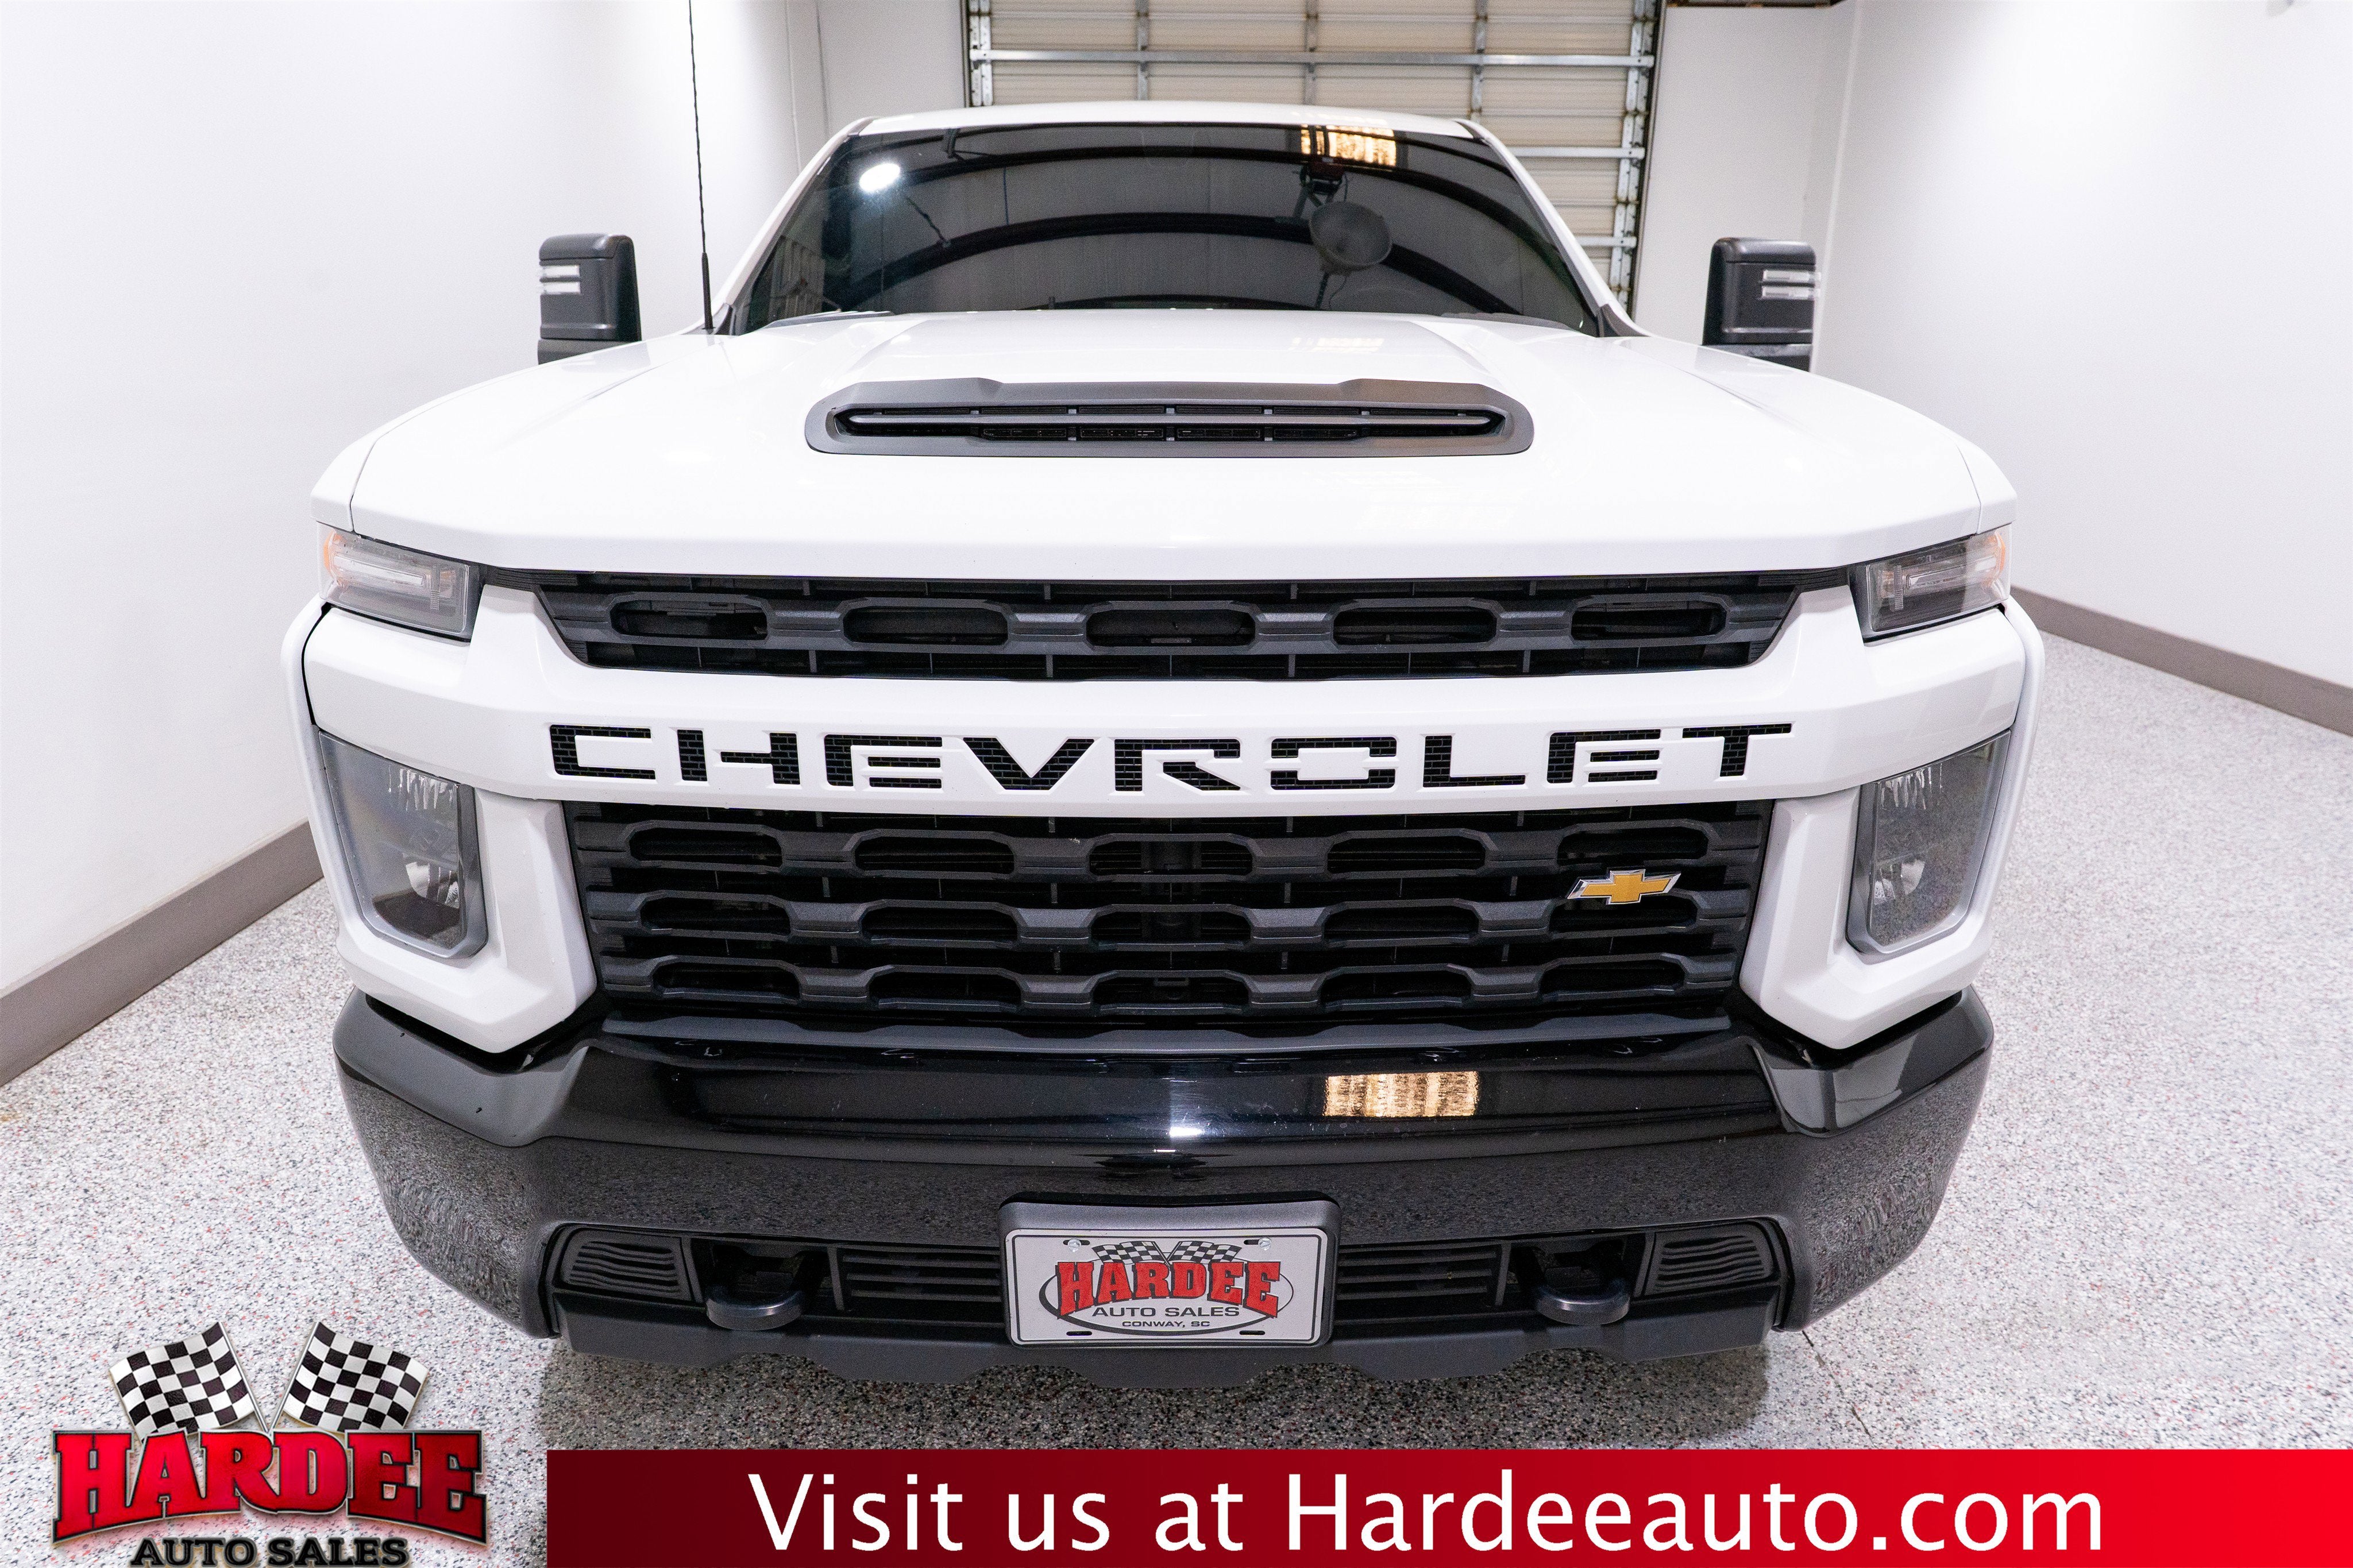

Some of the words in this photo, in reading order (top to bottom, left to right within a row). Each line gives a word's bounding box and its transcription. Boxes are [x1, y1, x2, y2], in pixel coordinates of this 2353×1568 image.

[549, 722, 1793, 791] CHEVROLET
[1055, 1261, 1281, 1319] HARDEE
[1092, 1307, 1156, 1318] AUTO
[1164, 1307, 1240, 1317] SALES
